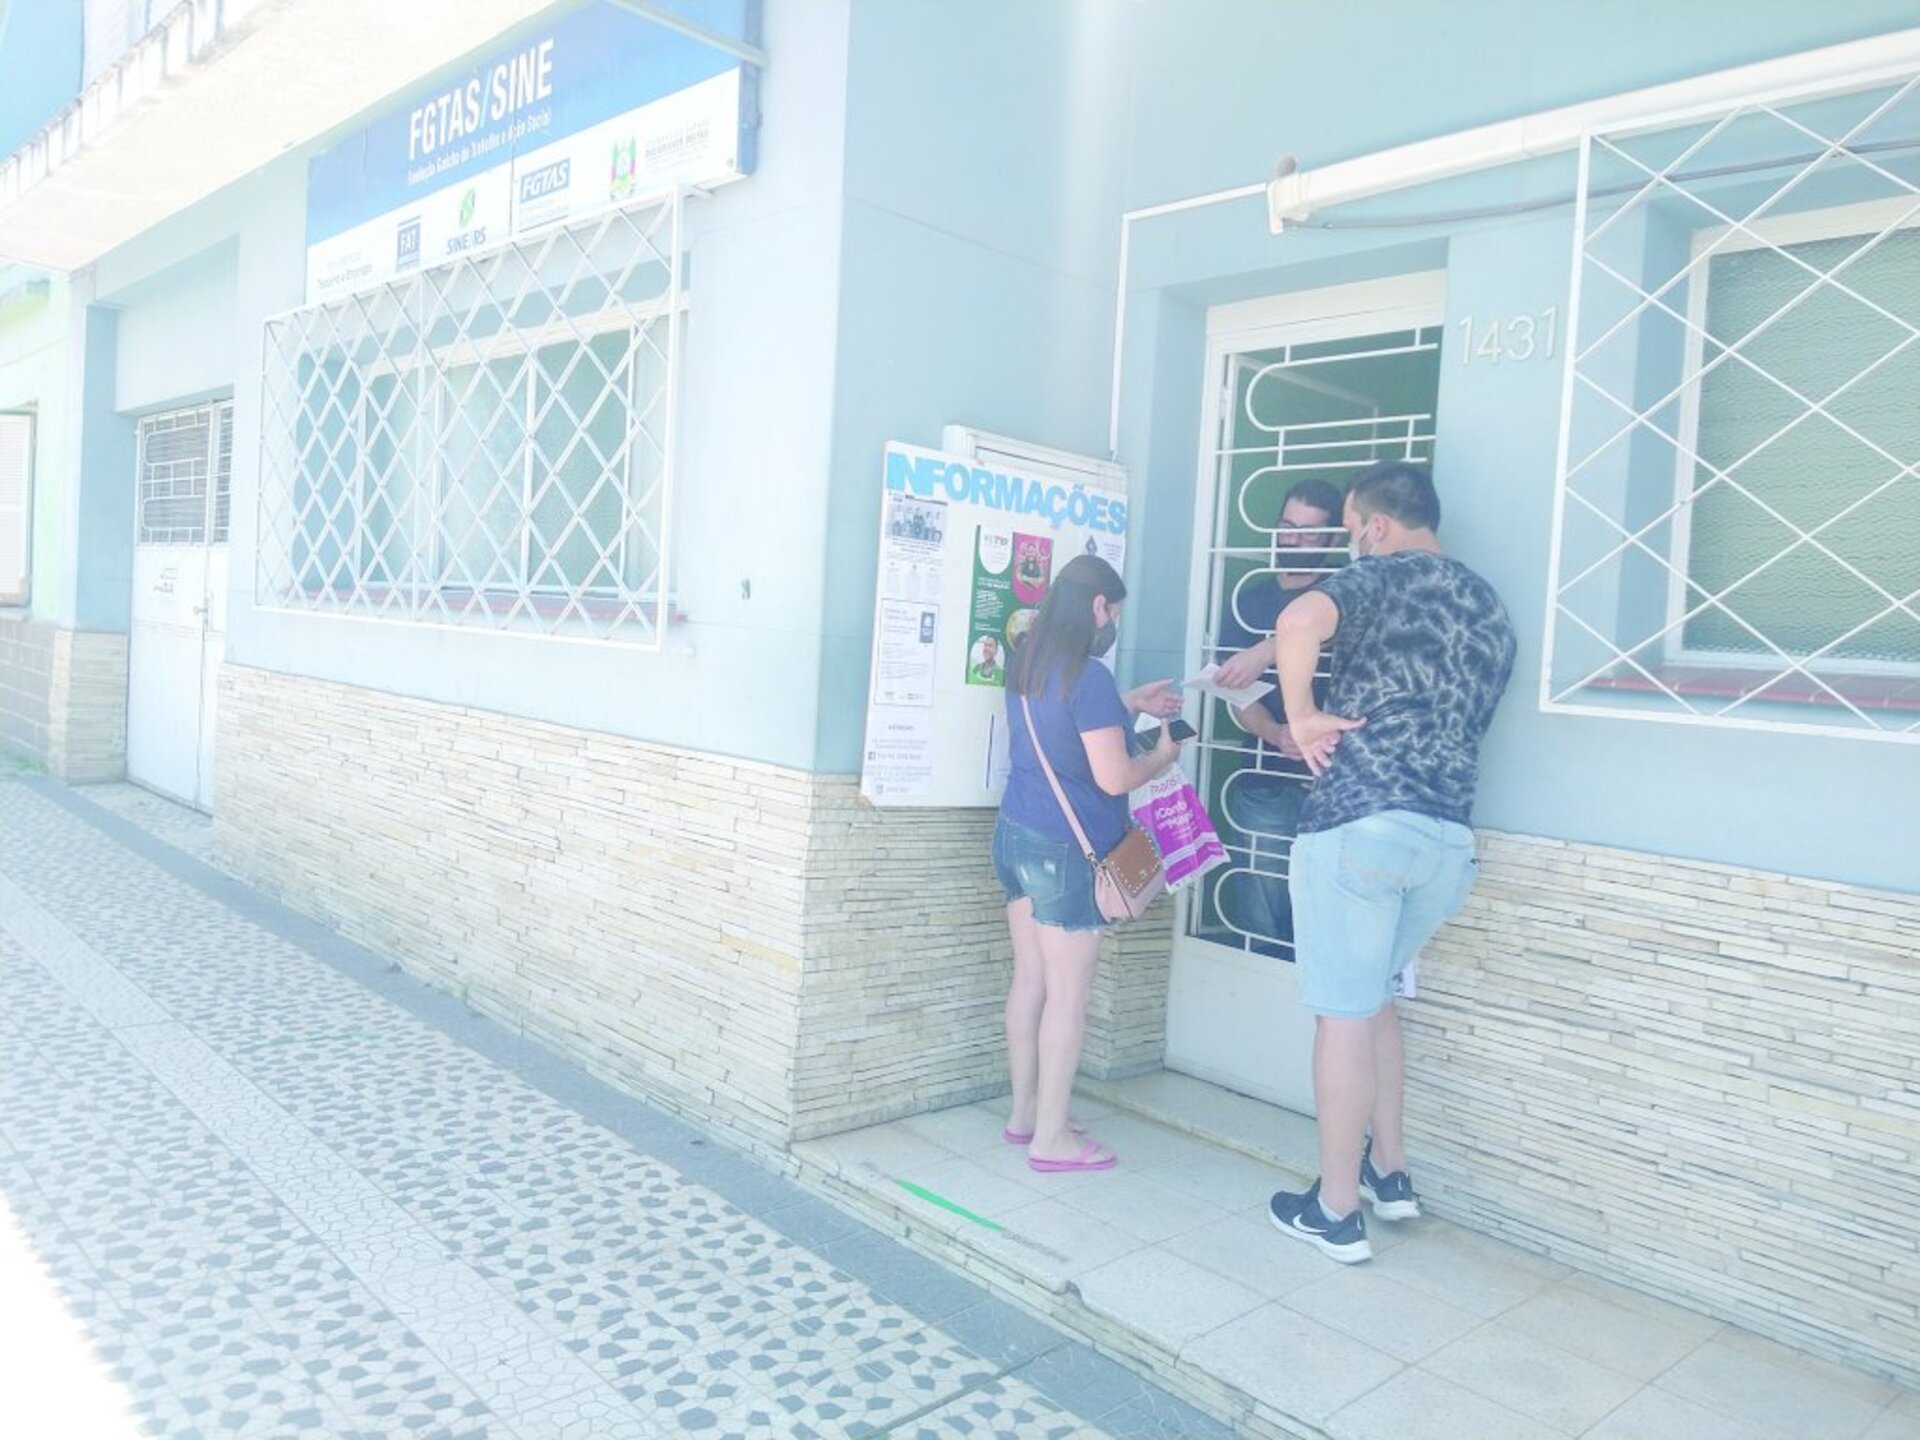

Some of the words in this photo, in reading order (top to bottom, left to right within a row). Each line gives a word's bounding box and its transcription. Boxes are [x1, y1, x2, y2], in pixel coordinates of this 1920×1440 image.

[408, 37, 555, 161] FGTAS/SINE
[522, 161, 569, 200] FGTAS
[1457, 304, 1559, 366] 1431
[886, 450, 1127, 536] INFORMAÇÕES
